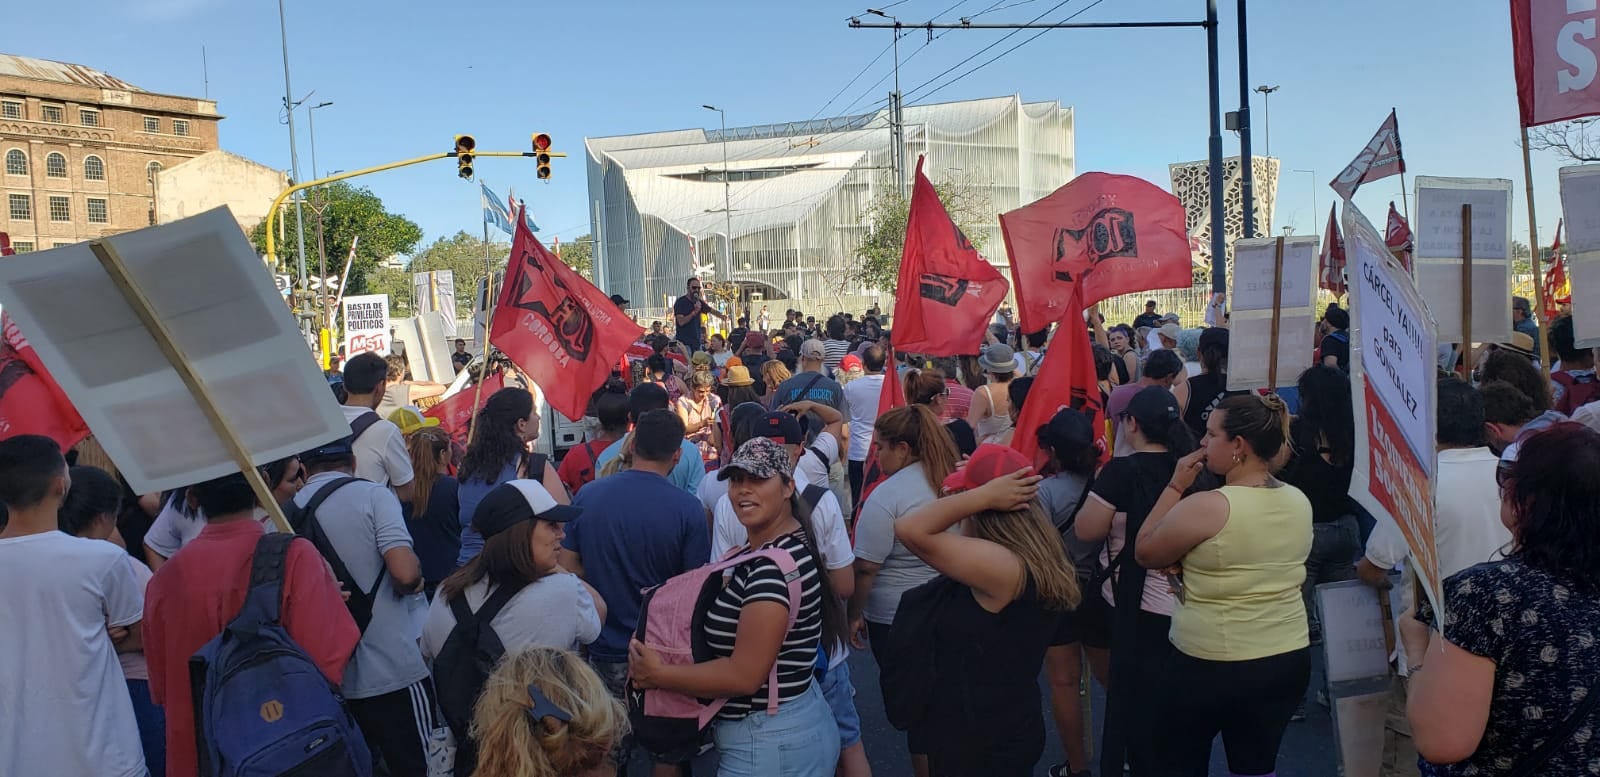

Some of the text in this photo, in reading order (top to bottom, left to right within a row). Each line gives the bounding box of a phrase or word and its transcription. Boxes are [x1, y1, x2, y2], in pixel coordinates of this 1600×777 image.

[1363, 261, 1395, 316] CÁRCEL
[347, 310, 383, 320] PRIVILEGIOS
[372, 302, 383, 311] DE
[351, 334, 384, 352] MST
[1383, 325, 1402, 362] para
[1373, 337, 1418, 420] GONZALEZ
